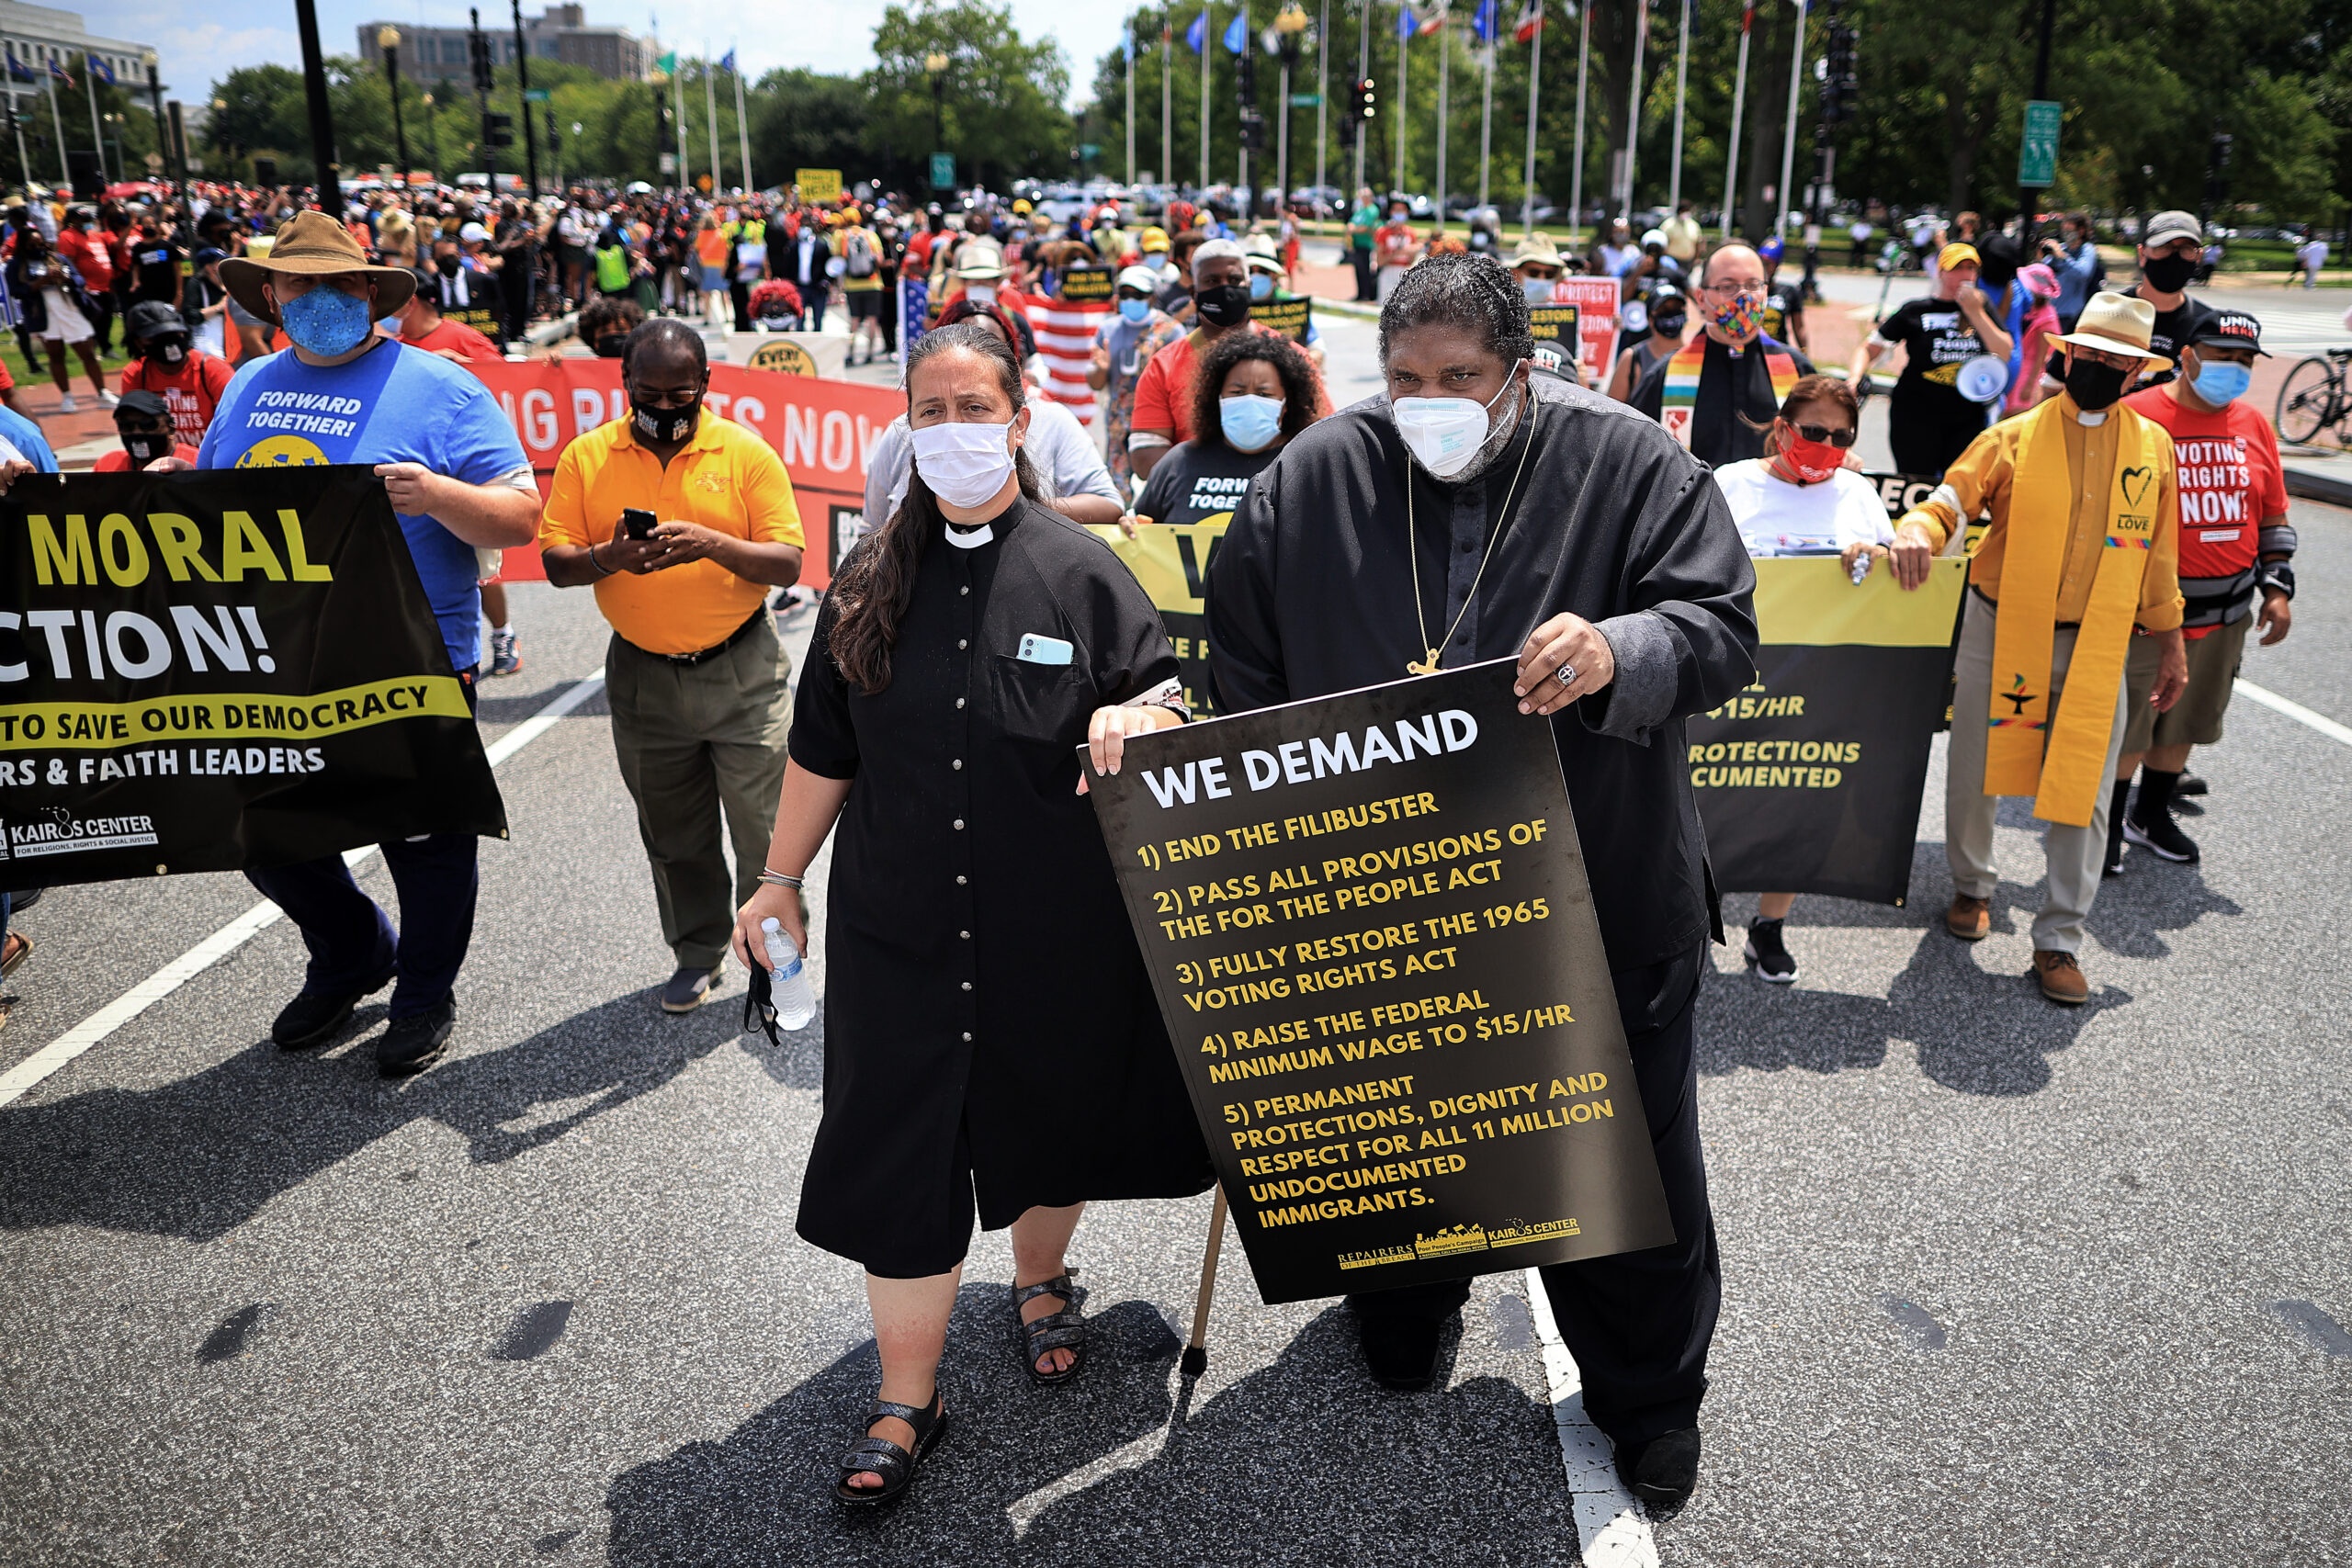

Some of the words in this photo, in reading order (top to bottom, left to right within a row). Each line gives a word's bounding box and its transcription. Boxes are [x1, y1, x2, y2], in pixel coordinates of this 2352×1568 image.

[246, 412, 356, 438] TOGETHER!
[255, 391, 362, 415] FORWARD
[2175, 441, 2246, 465] VOTING
[2177, 466, 2251, 489] RIGHTS
[2117, 517, 2151, 532] LOVE
[2179, 490, 2249, 525] NOW!
[27, 508, 334, 588] MORAL
[57, 713, 130, 740] SAVE
[141, 705, 215, 733] OUR
[223, 684, 430, 732] DEMOCRACY
[45, 758, 70, 786] &
[79, 749, 180, 784] FAITH
[189, 747, 326, 775] LEADERS
[1140, 756, 1232, 809] WE
[1240, 709, 1478, 792] DEMAND
[17, 847, 32, 855] FOR
[74, 840, 97, 850] RIGHTS
[105, 838, 129, 847] SOCIAL
[85, 814, 154, 837] CENTER
[1136, 844, 1160, 871] 1)
[1165, 834, 1221, 863] END
[1225, 822, 1280, 850] THE
[1283, 792, 1440, 840] FILIBUSTER
[1153, 888, 1183, 915] 2)
[1188, 874, 1261, 907] PASS
[1269, 865, 1318, 893] ALL
[1322, 829, 1502, 882] PROVISIONS
[1508, 818, 1547, 845] OF
[1159, 914, 1213, 941] THE
[1216, 904, 1274, 931] FOR
[1276, 892, 1330, 919] THE
[1335, 872, 1441, 910] PEOPLE
[1448, 859, 1502, 890] ACT
[1175, 961, 1204, 987] 3)
[1208, 945, 1287, 978] FULLY
[1295, 922, 1419, 964] RESTORE
[1423, 911, 1478, 940] THE
[1483, 897, 1550, 929] 1965
[1182, 977, 1291, 1012] VOTING
[1295, 958, 1397, 994] RIGHTS
[1405, 946, 1457, 976] ACT
[1201, 1033, 1227, 1058] 4)
[1232, 1020, 1311, 1050] RAISE
[1313, 1010, 1366, 1036] THE
[1371, 989, 1490, 1027] FEDERAL
[1208, 1046, 1335, 1084] MINIMUM
[1337, 1030, 1423, 1062] WAGE
[1427, 1023, 1467, 1046] TO
[1475, 1004, 1575, 1042] $15/HR
[1223, 1102, 1250, 1126] 5)
[1254, 1075, 1414, 1119] PERMANENT
[1230, 1104, 1424, 1150] PROTECTIONS,
[1429, 1082, 1539, 1119] DIGNITY
[1548, 1072, 1608, 1100] AND
[1240, 1143, 1350, 1177] RESPECT
[1356, 1134, 1412, 1159] FOR
[1419, 1125, 1467, 1150] ALL
[1471, 1120, 1495, 1140] 11
[1500, 1098, 1614, 1136] MILLION
[1249, 1154, 1466, 1202] UNDOCUMENTED
[1258, 1187, 1435, 1228] IMMIGRANTS.
[1533, 1217, 1578, 1233] CENTER
[1338, 1244, 1413, 1263] REPAIRERS
[1382, 1253, 1414, 1263] BREACH
[1456, 1237, 1486, 1246] Campaign
